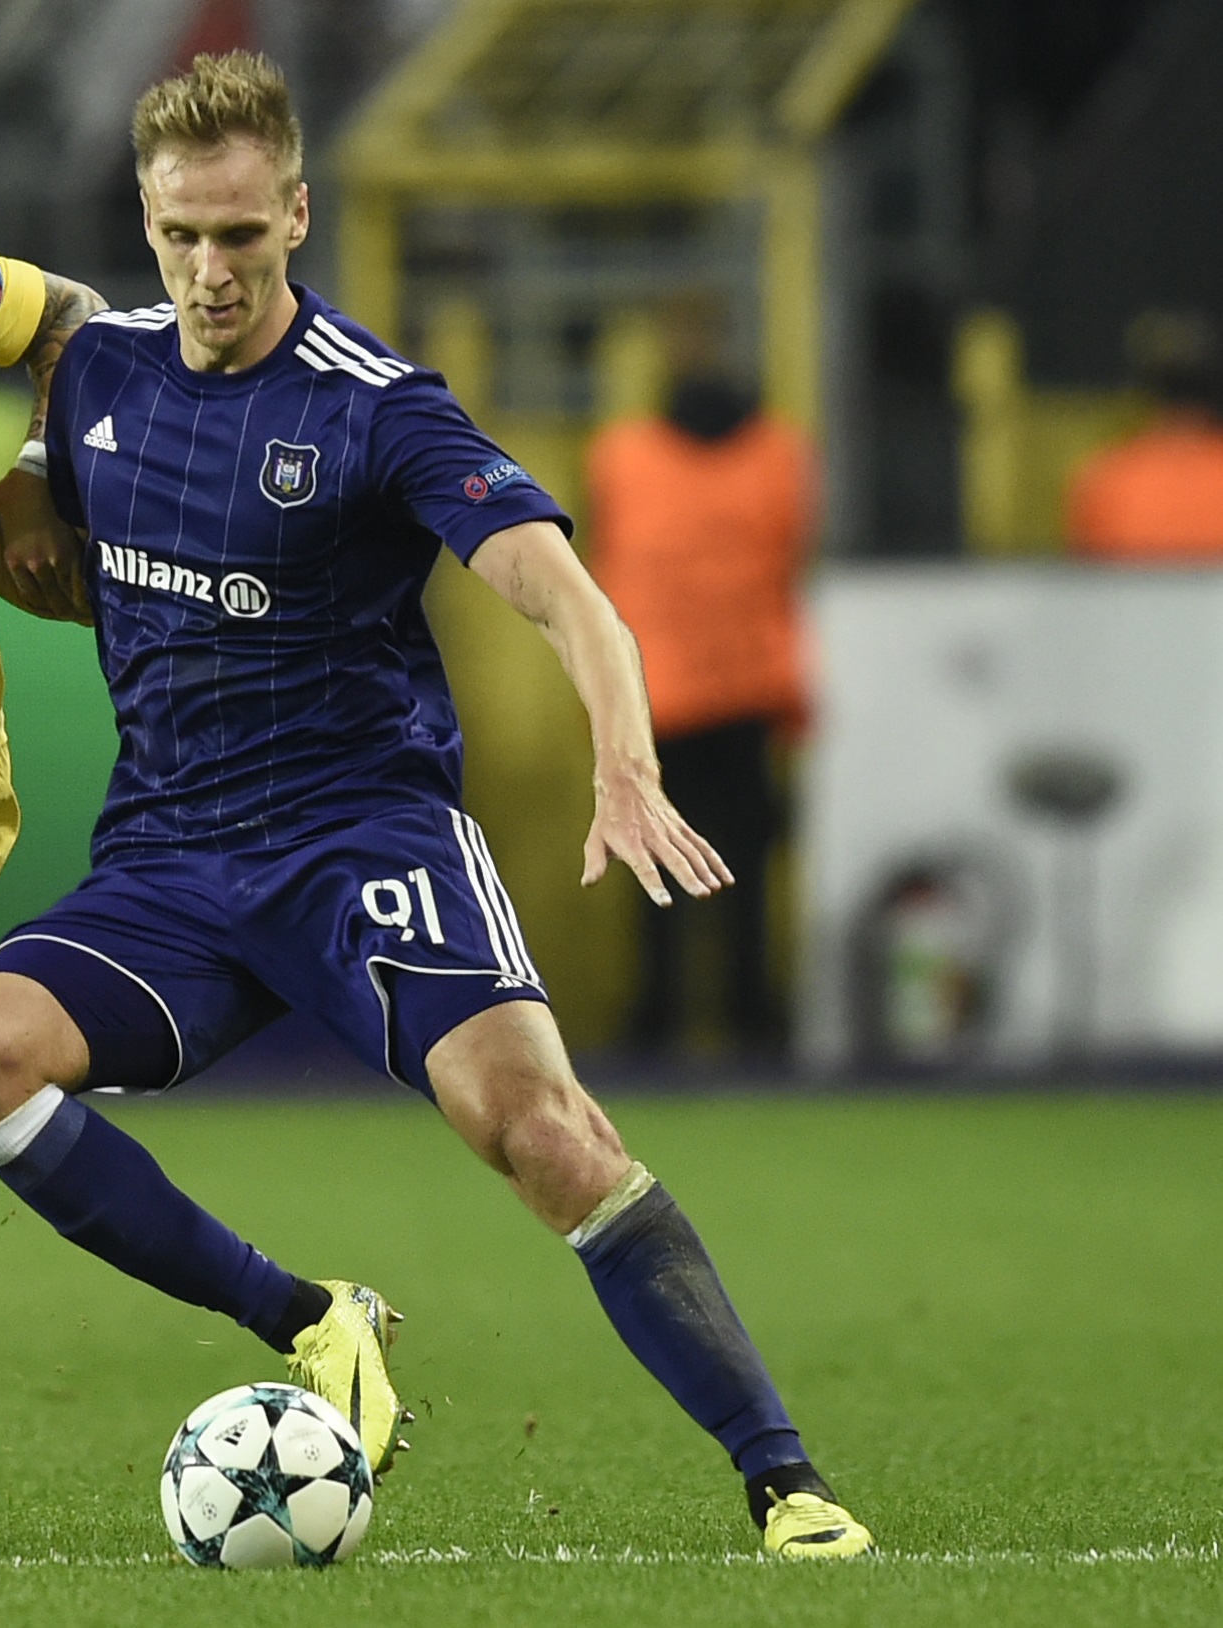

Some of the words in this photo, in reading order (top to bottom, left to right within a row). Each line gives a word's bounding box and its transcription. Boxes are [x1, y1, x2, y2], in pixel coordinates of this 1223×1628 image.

[83, 433, 118, 453] adidas
[97, 540, 214, 603] Allianz
[361, 867, 445, 944] 91
